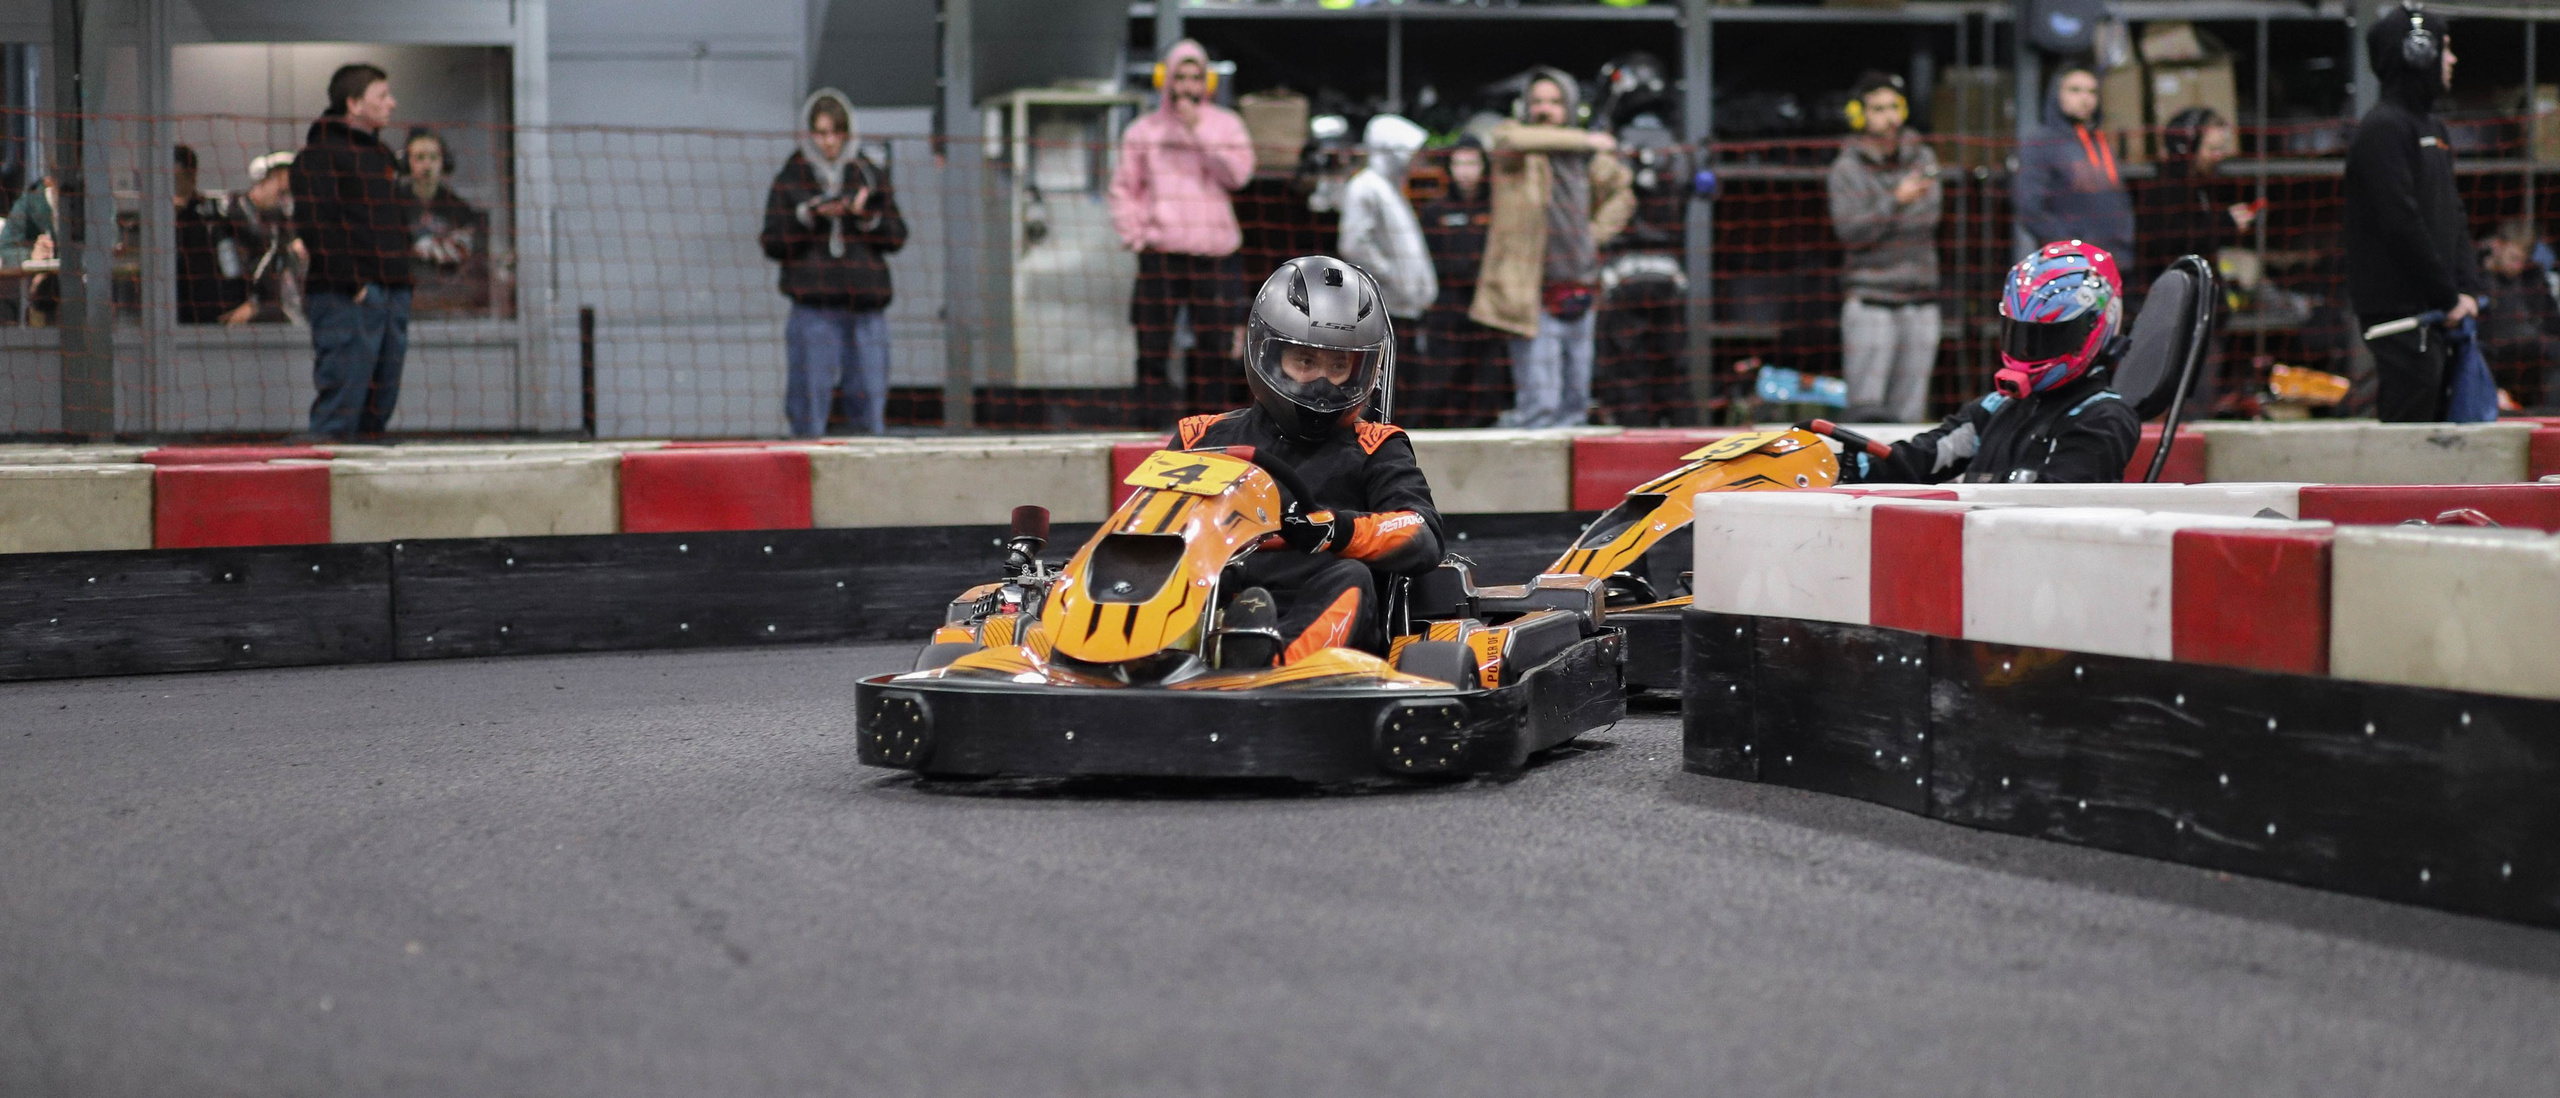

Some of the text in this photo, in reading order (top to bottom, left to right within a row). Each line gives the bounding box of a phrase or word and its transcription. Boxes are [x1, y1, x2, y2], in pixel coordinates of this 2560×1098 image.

[1310, 320, 1357, 332] LS2
[1709, 437, 1760, 454] 5
[1158, 463, 1211, 485] 4
[1487, 636, 1499, 645] OF
